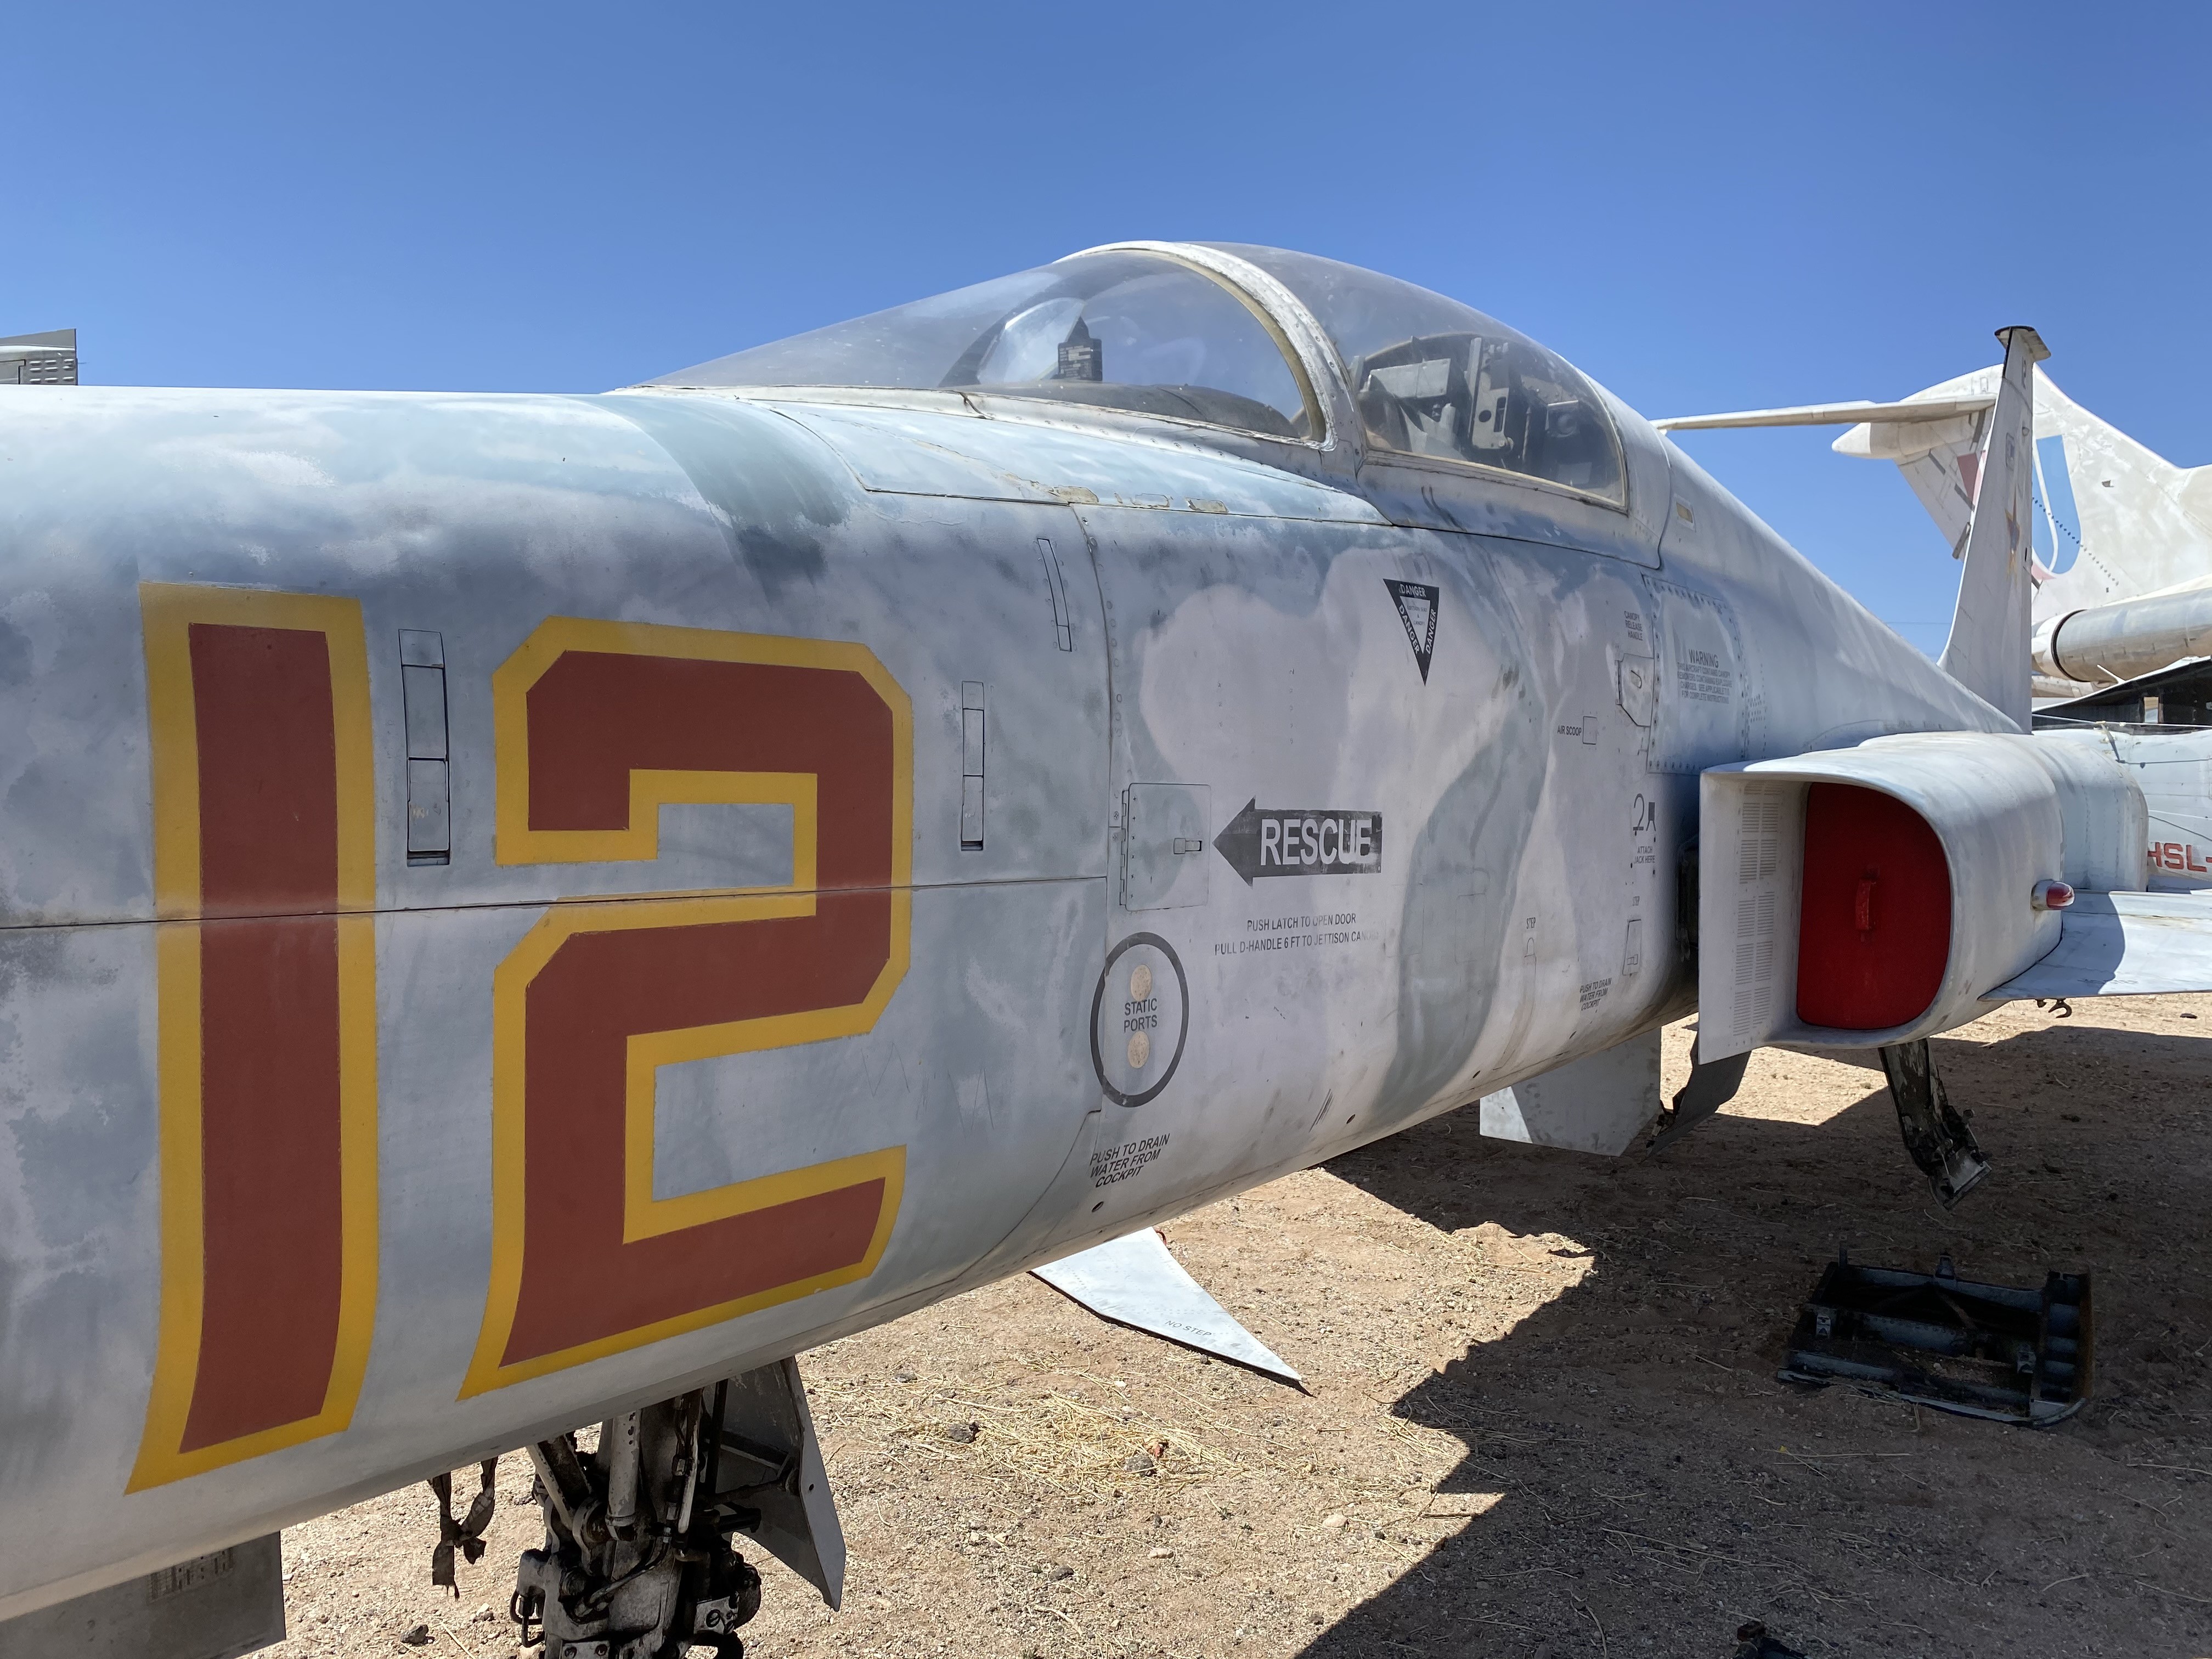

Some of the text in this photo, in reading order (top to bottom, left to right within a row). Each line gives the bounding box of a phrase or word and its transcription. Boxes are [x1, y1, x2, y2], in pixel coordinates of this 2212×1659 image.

[1400, 583, 1426, 597] DANGER
[1624, 611, 1640, 622] CANOPY
[1625, 620, 1643, 631] RELEASE
[1399, 604, 1419, 654] DANGER
[1426, 608, 1436, 654] DANGER
[1628, 630, 1643, 641] HANDLE
[1689, 649, 1719, 668] WARNING
[1566, 726, 1582, 736] SCOOP
[1260, 818, 1372, 866] RESCUE
[1247, 913, 1356, 932] PUSH LATCH TO OPEN DOOR
[1526, 917, 1536, 929] STEP
[1215, 943, 1237, 956] PULL
[1240, 938, 1282, 953] D-HANDLE
[1284, 937, 1289, 949] 6
[1291, 936, 1300, 948] FT
[1302, 935, 1312, 946] TO
[1314, 932, 1349, 945] JETTISON
[1580, 977, 1612, 994] PUSH TO DRAIN
[1580, 988, 1608, 1003] WATER FROM
[1581, 998, 1601, 1011] COCKPIT
[1125, 998, 1157, 1016] STATIC
[1124, 1014, 1157, 1033] PORTS
[125, 582, 912, 1493] 12
[1090, 1133, 1170, 1166] PUSH TO DRAIN
[1090, 1148, 1161, 1178] WATER FROM
[1096, 1165, 1144, 1188] COCKPIT
[1183, 1325, 1212, 1336] STEP
